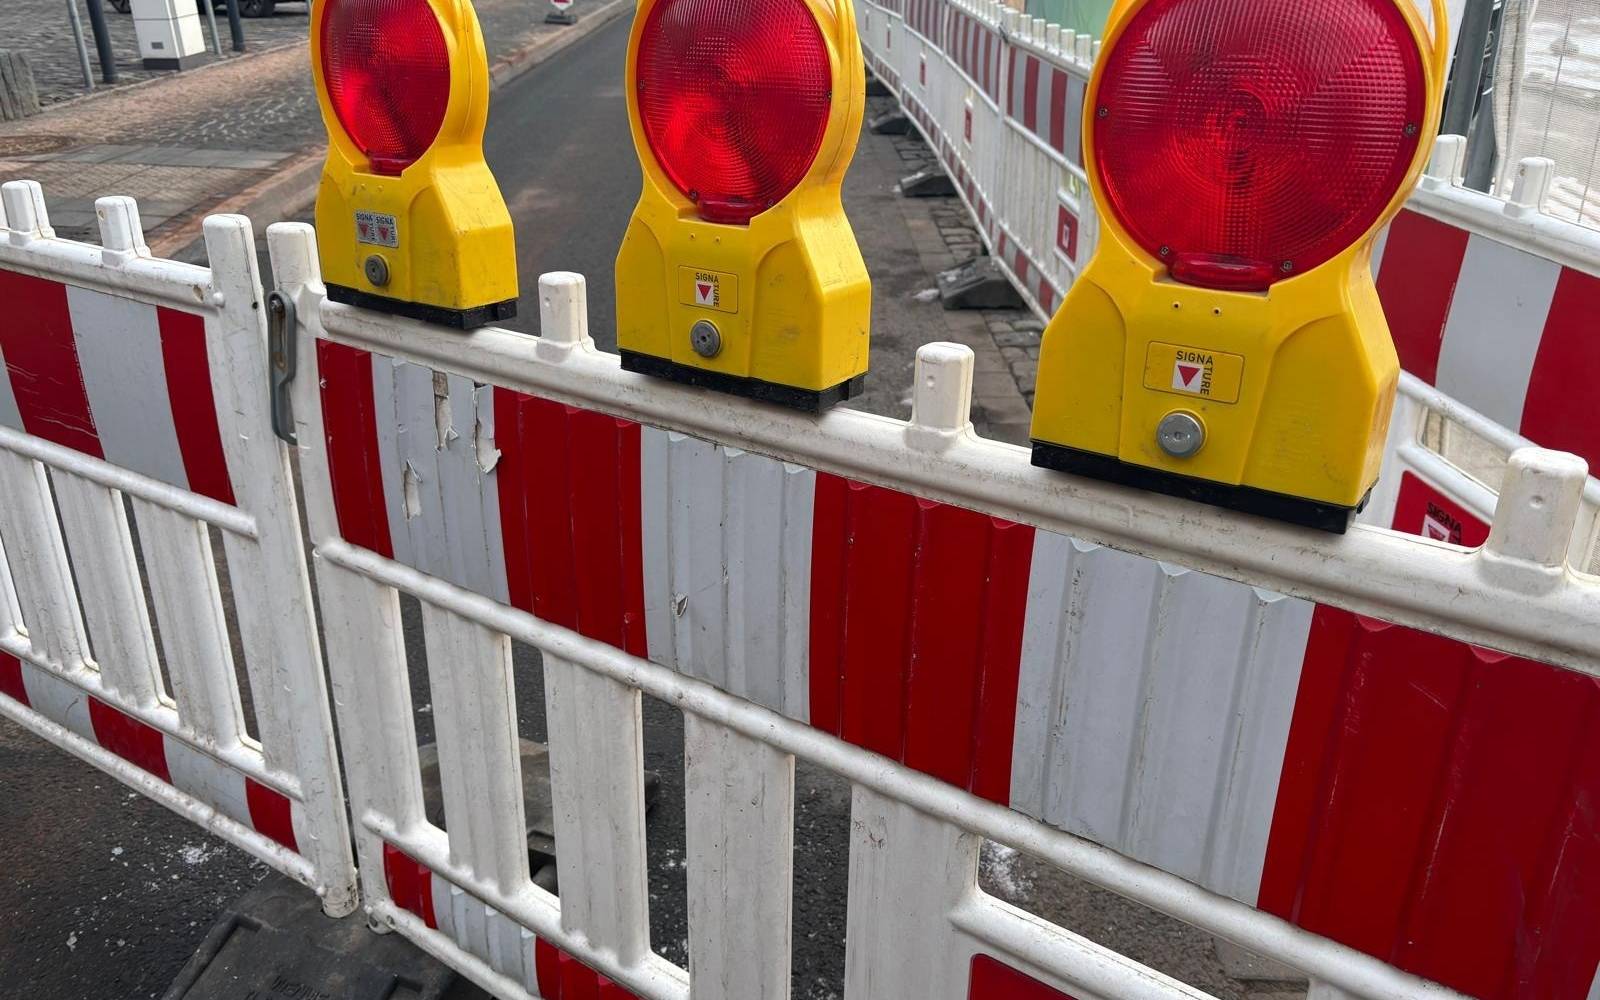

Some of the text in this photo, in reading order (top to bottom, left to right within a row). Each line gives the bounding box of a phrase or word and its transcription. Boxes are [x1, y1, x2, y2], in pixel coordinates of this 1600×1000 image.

[695, 273, 719, 283] SIGNA
[1176, 351, 1213, 365] SIGNA
[1200, 367, 1212, 395] TURE
[1427, 502, 1461, 531] SIGNA
